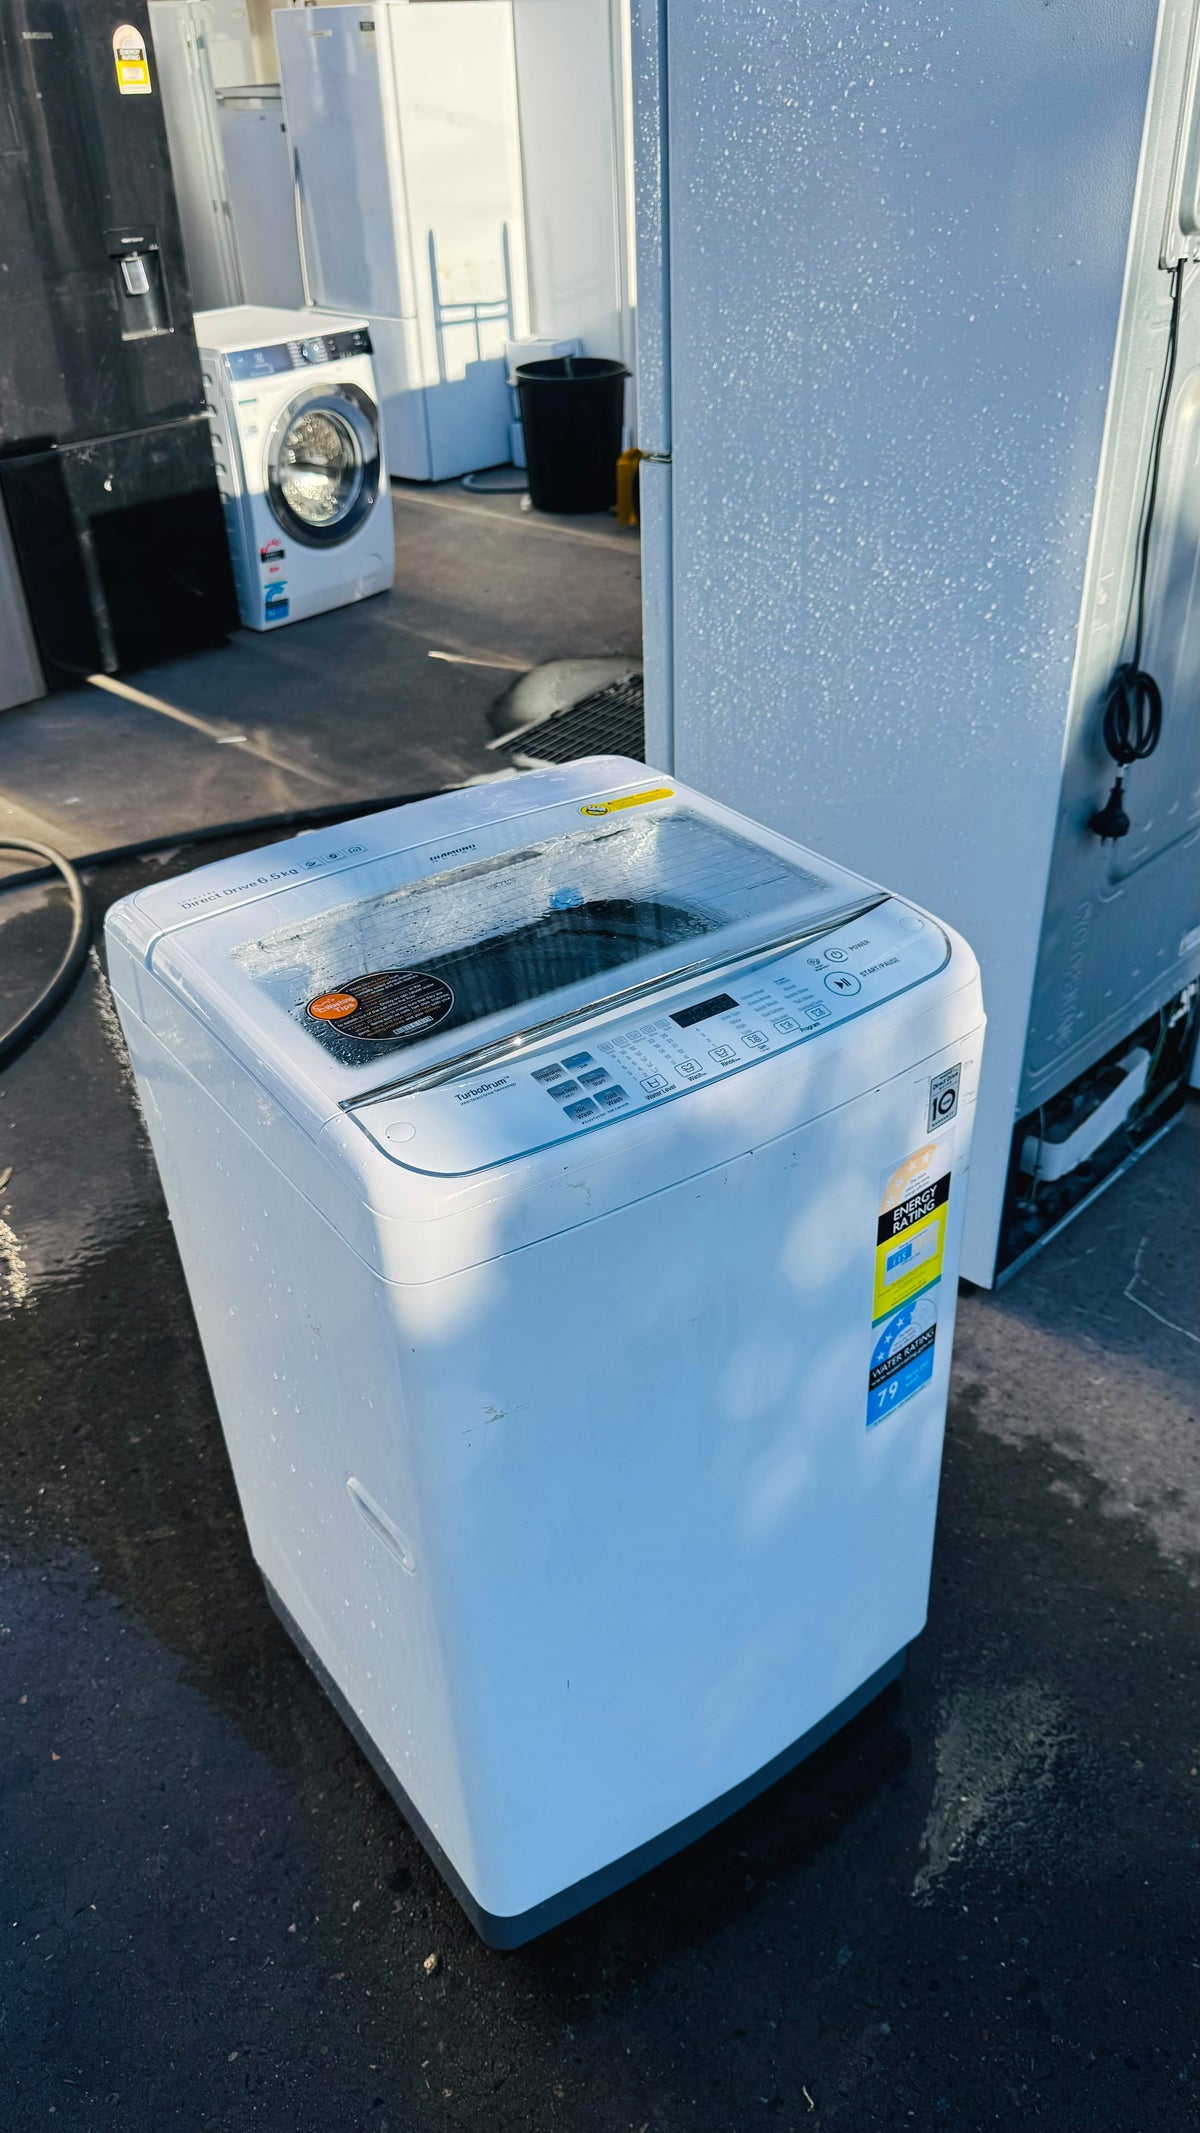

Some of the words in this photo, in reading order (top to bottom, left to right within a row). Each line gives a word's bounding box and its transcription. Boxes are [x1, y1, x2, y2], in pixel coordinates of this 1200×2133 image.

[182, 895, 222, 910] Direct
[224, 881, 257, 896] Drive
[848, 939, 871, 951] POWER
[860, 957, 901, 977] START/PAUSE
[325, 995, 354, 1012] Washing
[335, 1002, 356, 1014] Tips
[544, 1073, 561, 1083] Wash
[606, 1096, 624, 1106] Wash
[932, 1088, 956, 1121] 10
[576, 1110, 594, 1120] Wash
[893, 1185, 937, 1222] ENERGY
[892, 1198, 936, 1234] RATING
[872, 1351, 903, 1378] WATER
[904, 1327, 935, 1357] RATING
[877, 1380, 898, 1408] 79
